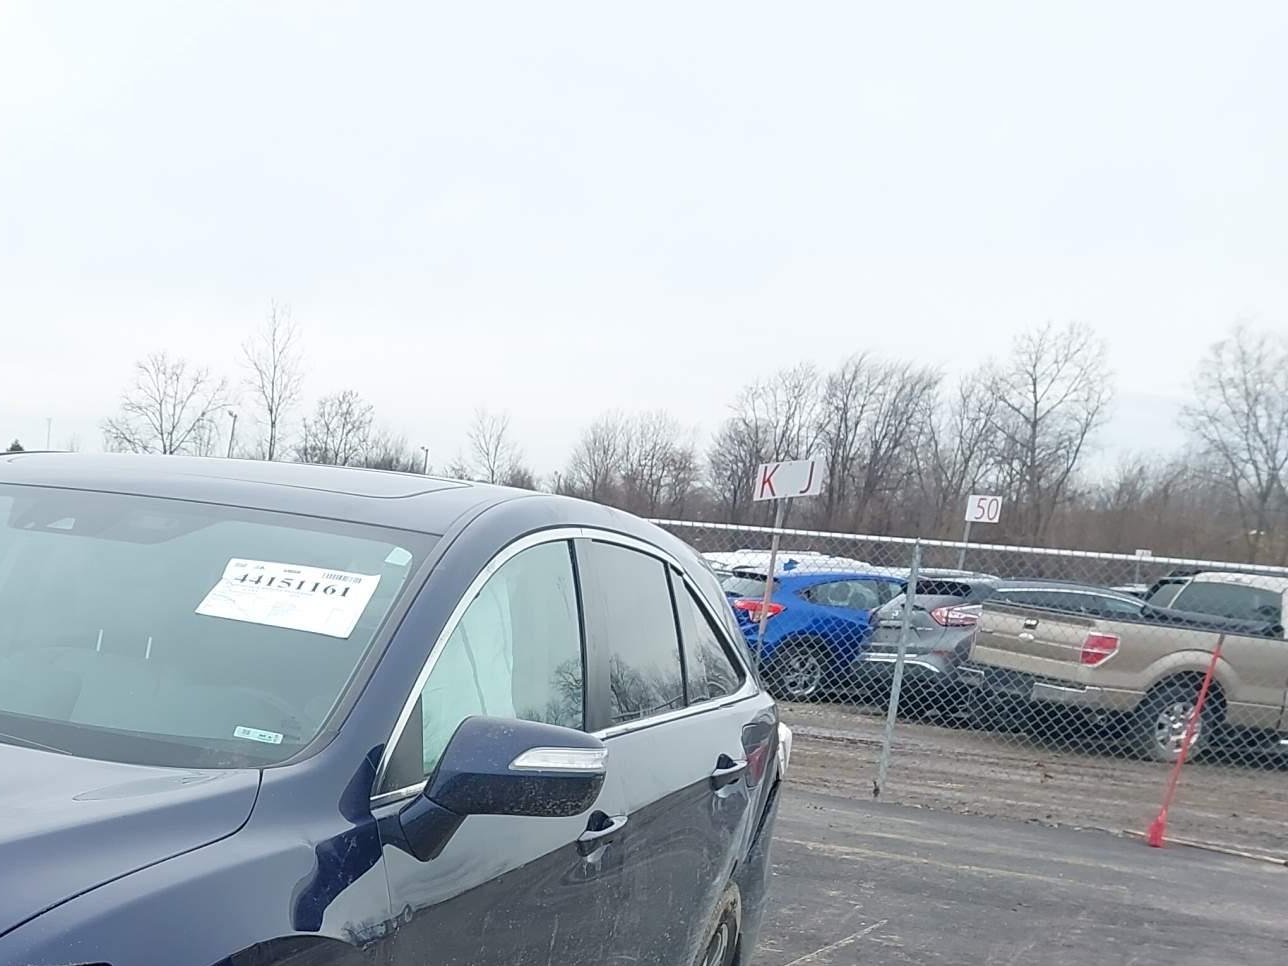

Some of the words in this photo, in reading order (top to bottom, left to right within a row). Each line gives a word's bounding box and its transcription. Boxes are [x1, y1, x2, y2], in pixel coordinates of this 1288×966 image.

[759, 463, 780, 498] K
[799, 461, 815, 494] J
[974, 497, 999, 521] 50
[234, 573, 351, 598] 44151161
